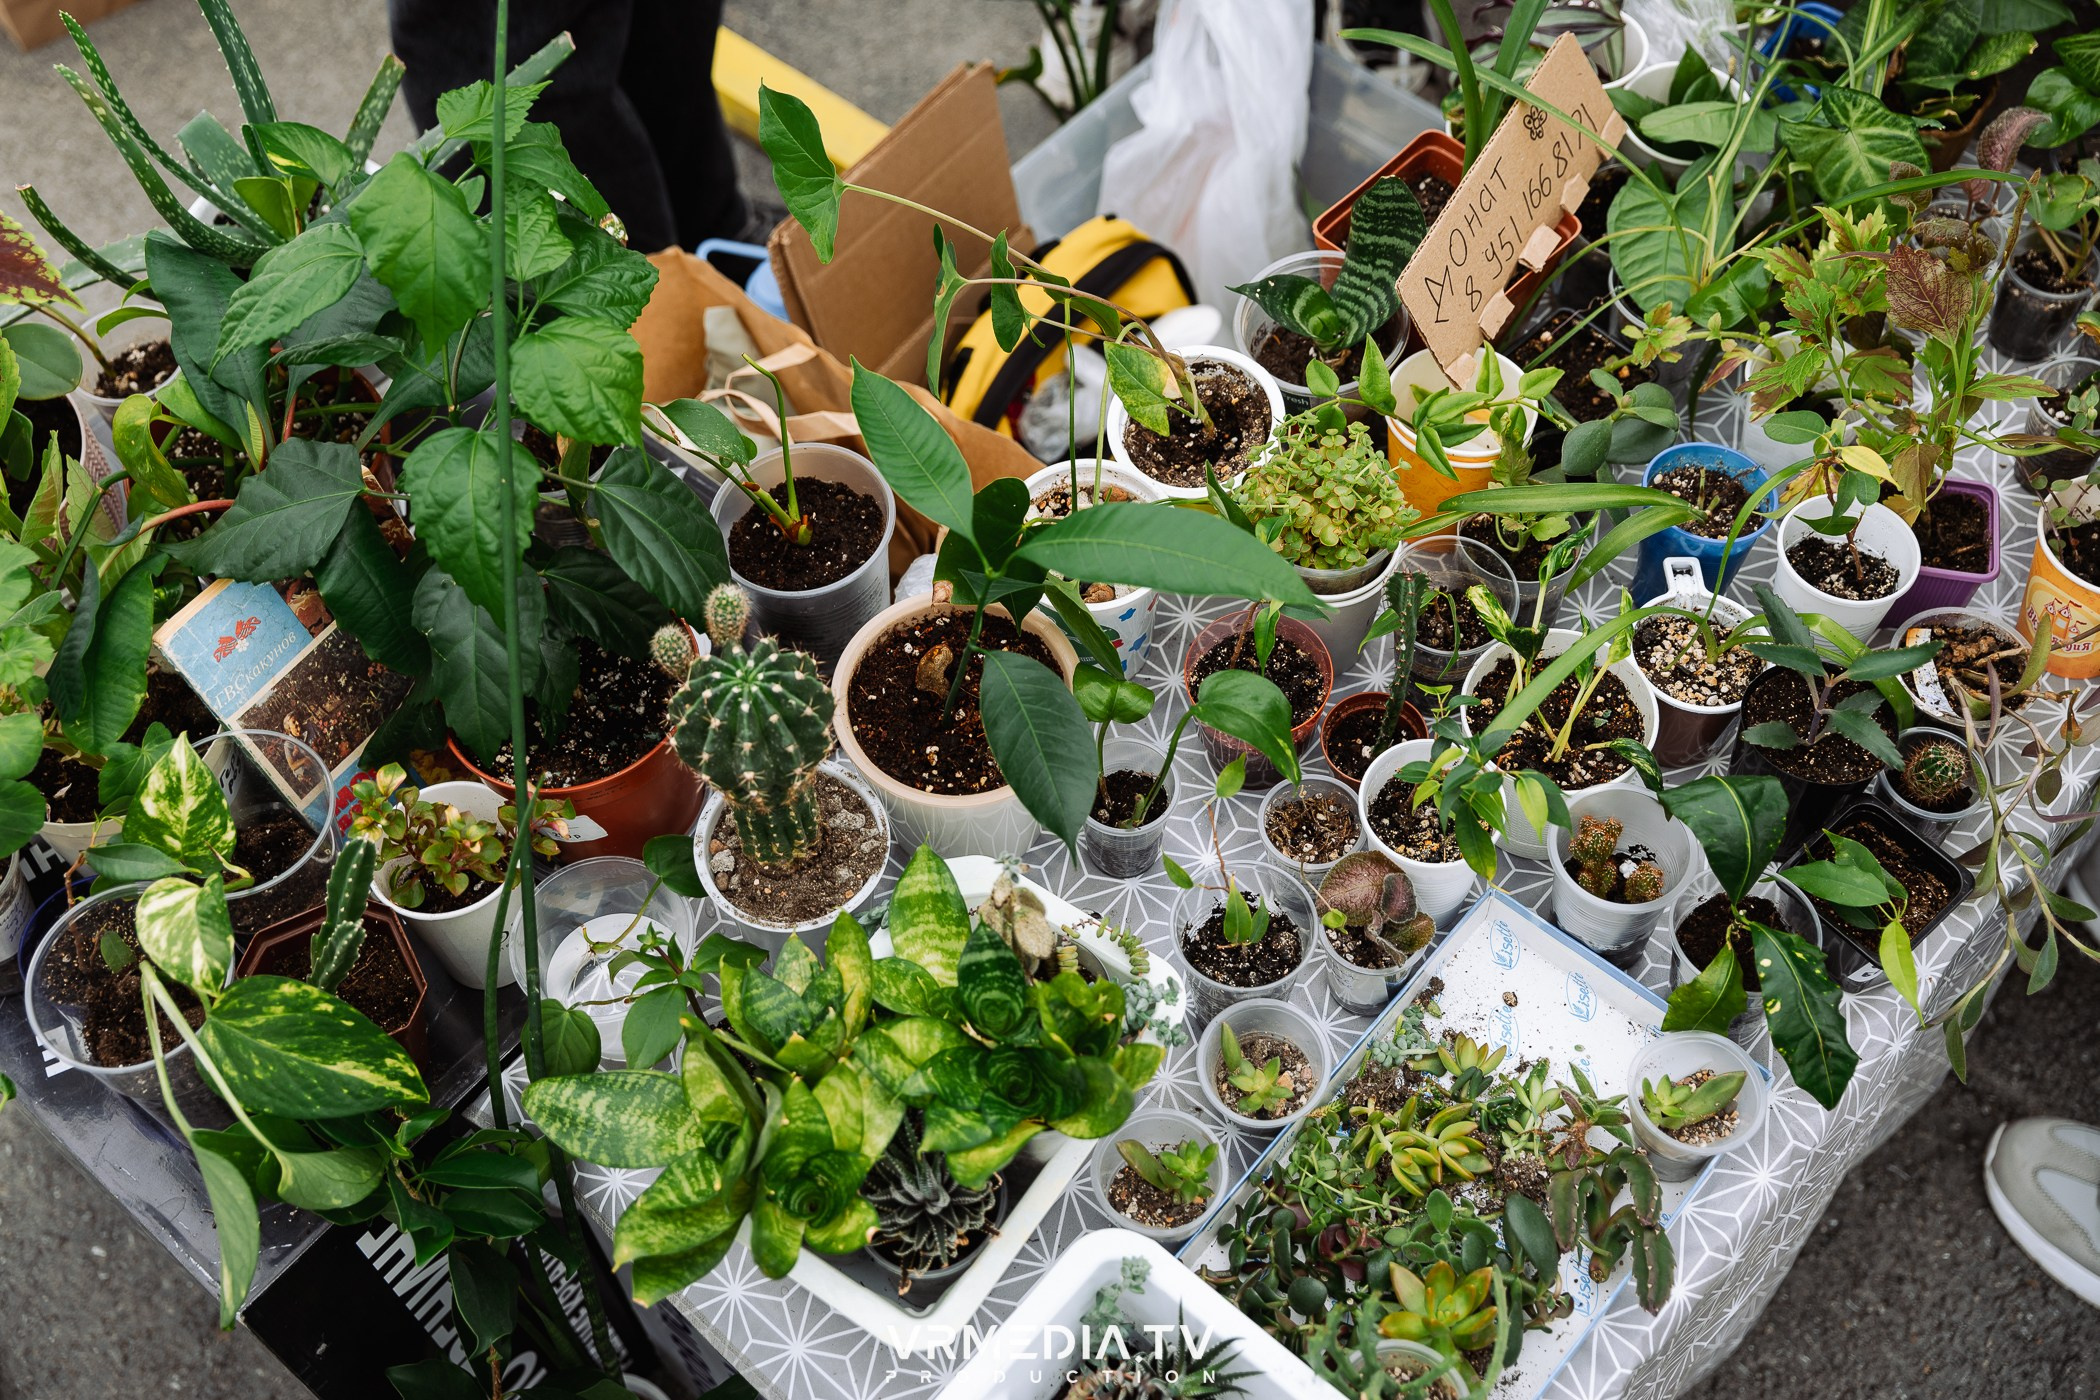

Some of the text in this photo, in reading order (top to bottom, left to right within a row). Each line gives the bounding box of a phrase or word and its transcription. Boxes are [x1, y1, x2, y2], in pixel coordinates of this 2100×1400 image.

[1465, 274, 1483, 313] 8
[1484, 215, 1523, 280] 951
[1492, 919, 1514, 970] Lisette
[1569, 971, 1590, 1022] Lisette
